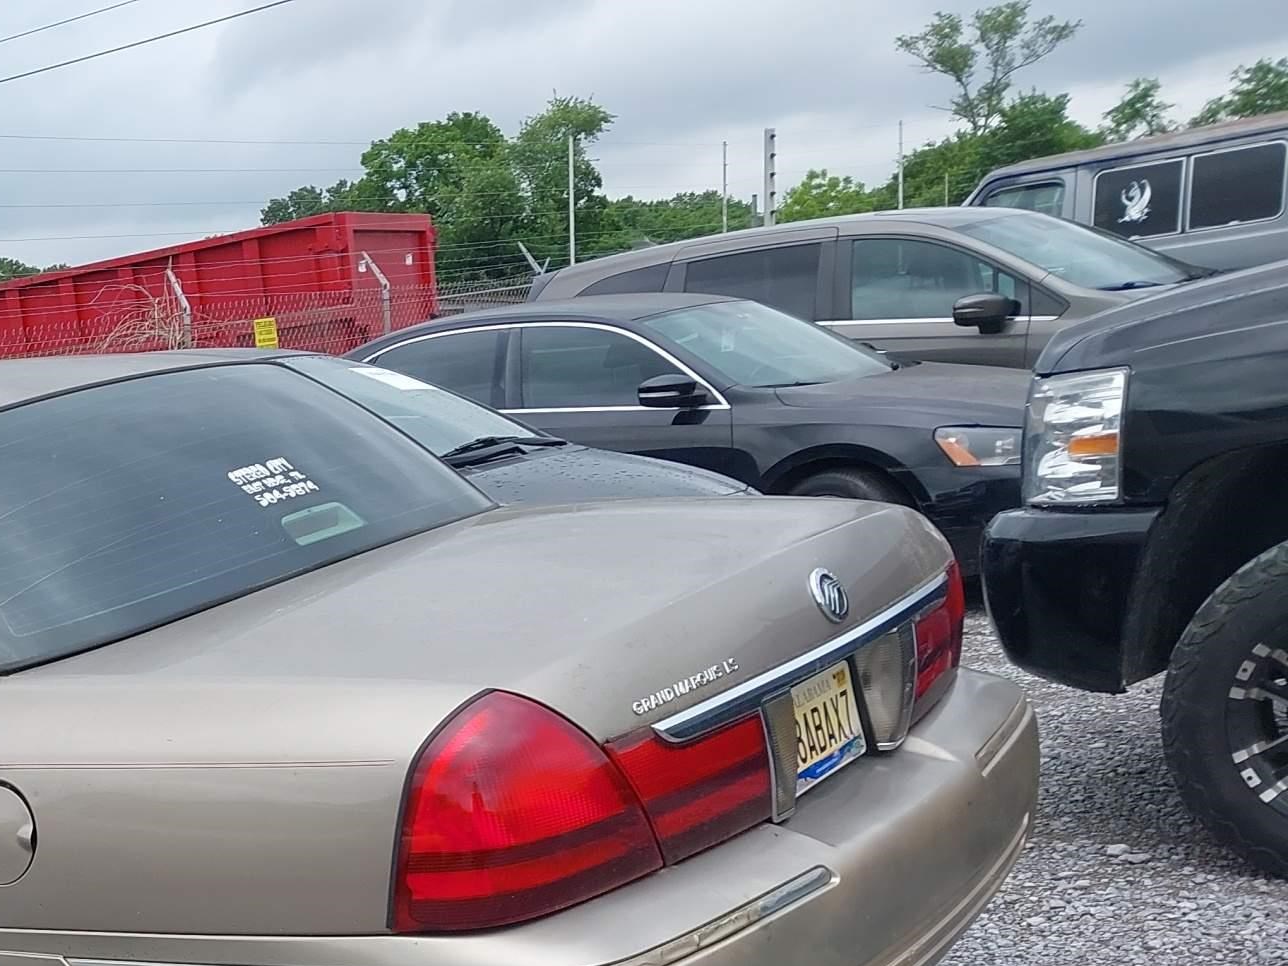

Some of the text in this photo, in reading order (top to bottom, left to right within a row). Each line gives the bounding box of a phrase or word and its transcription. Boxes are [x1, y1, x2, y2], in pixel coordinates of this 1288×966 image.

[228, 457, 294, 485] STEREO CITY
[632, 657, 739, 715] GRAND MARQUIS LS
